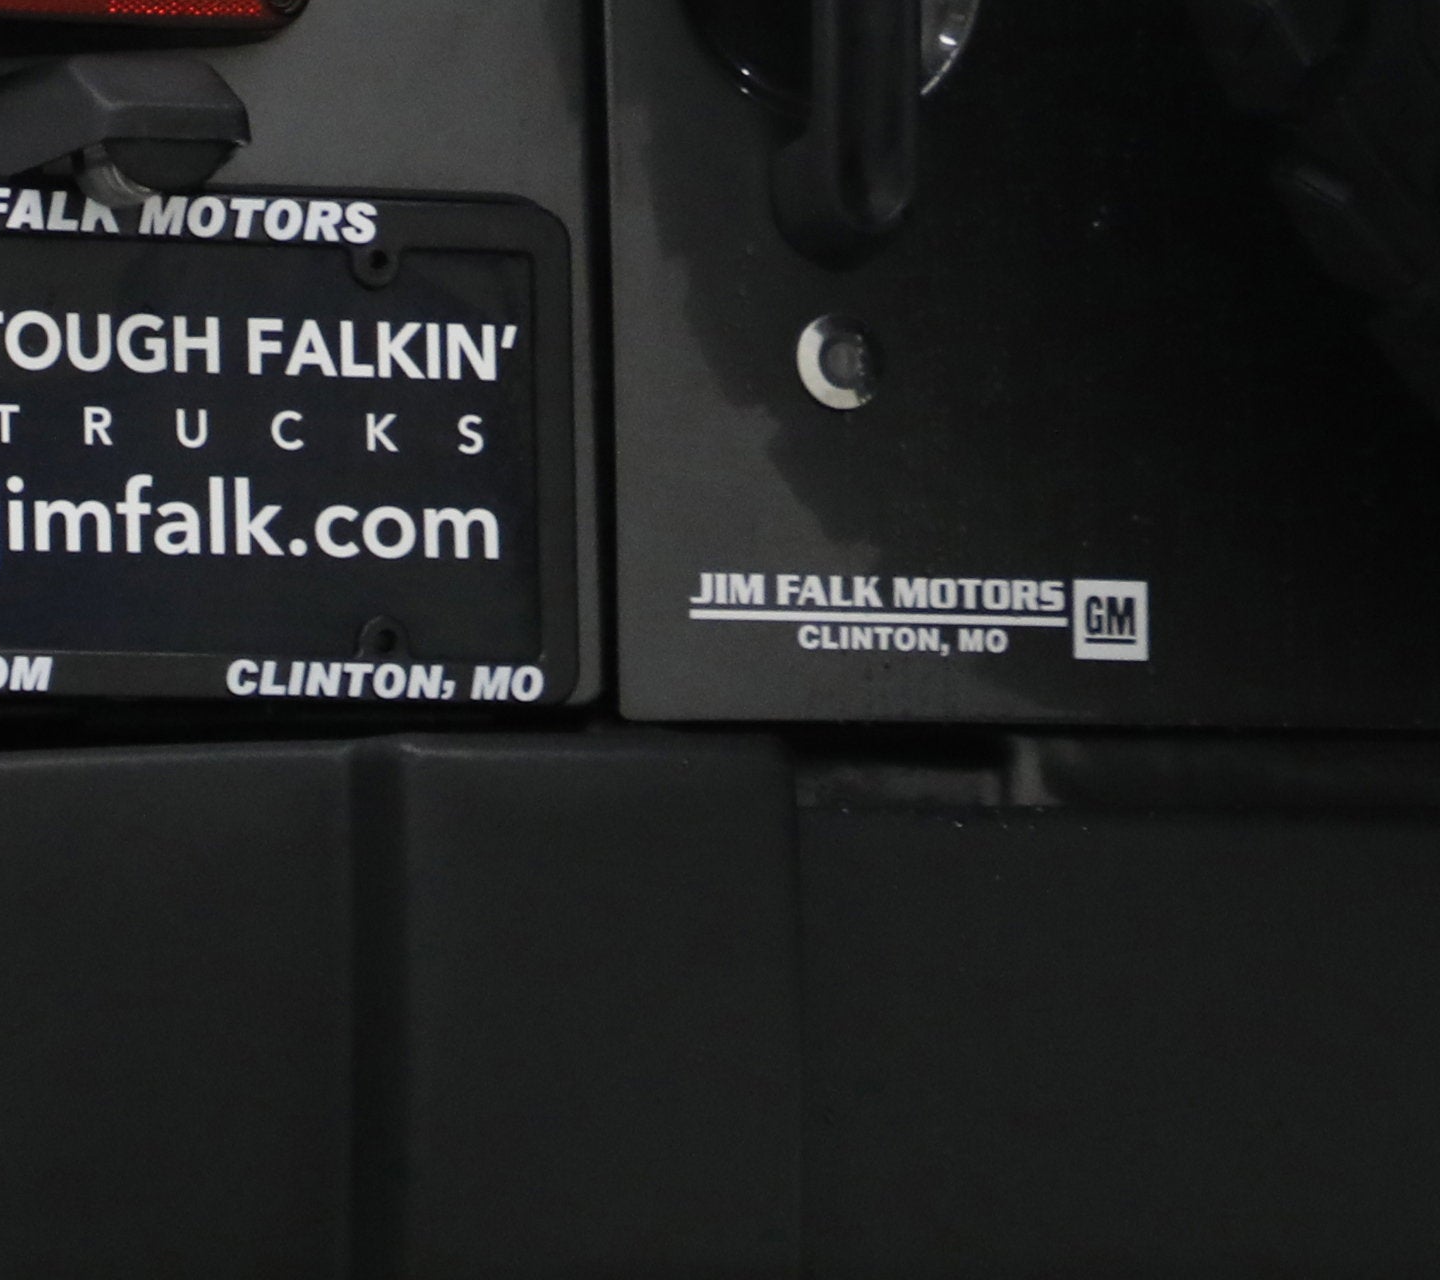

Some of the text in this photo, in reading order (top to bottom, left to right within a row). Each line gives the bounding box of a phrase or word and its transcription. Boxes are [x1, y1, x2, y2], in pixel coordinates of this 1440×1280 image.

[138, 194, 379, 245] MOTORS
[689, 571, 1066, 612] JIM FALK MOTORS
[1084, 596, 1136, 636] GM
[796, 624, 1009, 657] CLINTON, MO
[226, 658, 545, 702] CLINTON, MO
